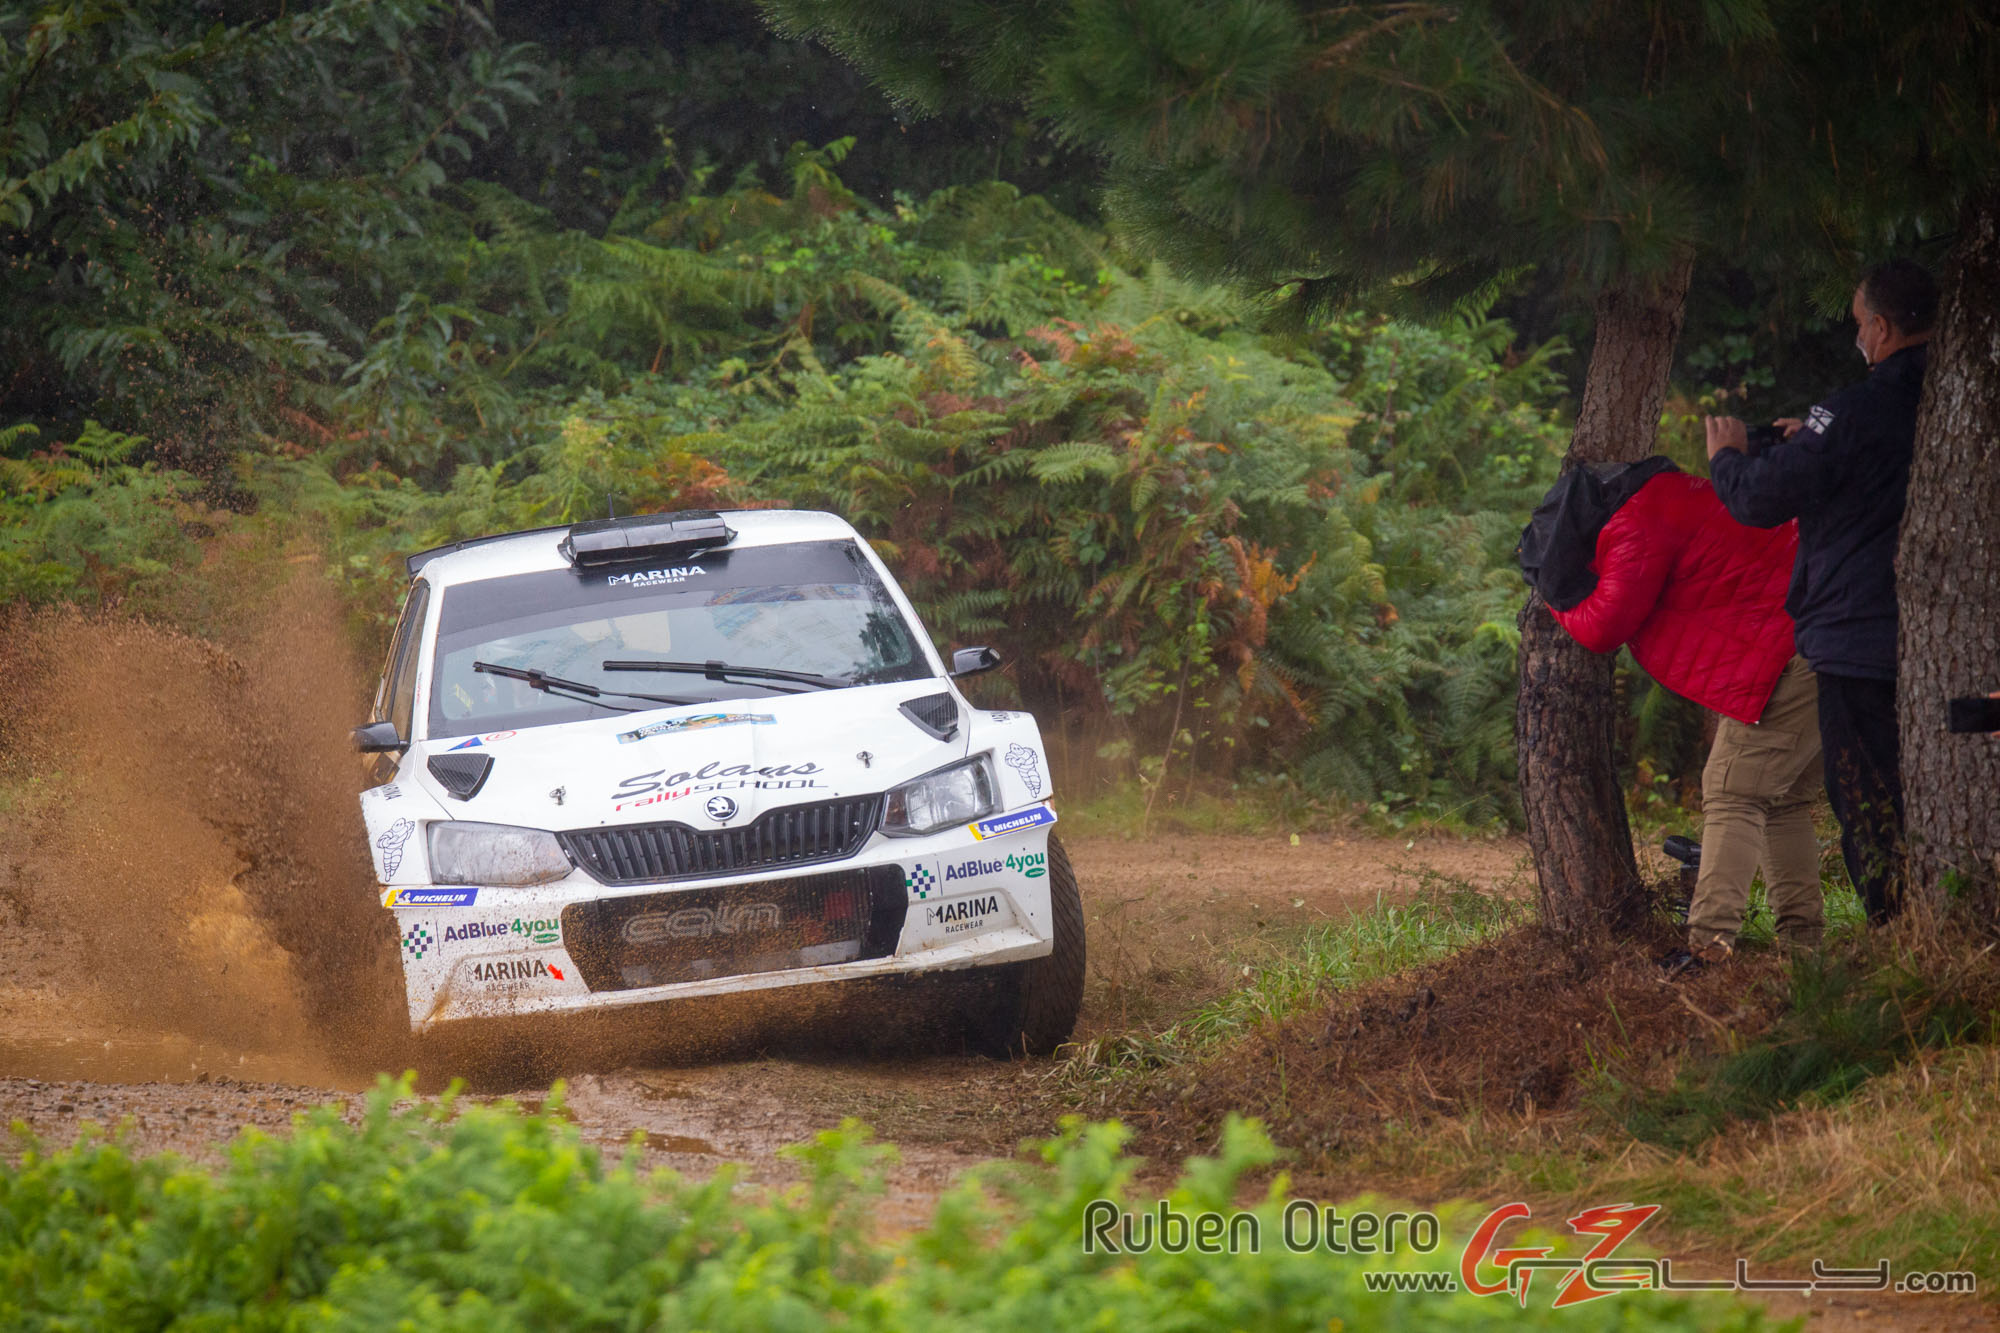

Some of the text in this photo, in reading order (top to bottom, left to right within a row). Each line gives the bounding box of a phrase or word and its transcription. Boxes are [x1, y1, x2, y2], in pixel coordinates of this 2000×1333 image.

[607, 565, 707, 586] MARINA
[633, 577, 686, 588] RACEWEAR
[611, 761, 825, 800] Solans
[994, 813, 1042, 833] MICHELIN
[412, 893, 468, 903] MICHELIN
[927, 896, 999, 926] MARINA
[945, 919, 984, 934] RACEWEAR
[464, 959, 549, 983] MARINA
[486, 982, 531, 992] RACEWEAR
